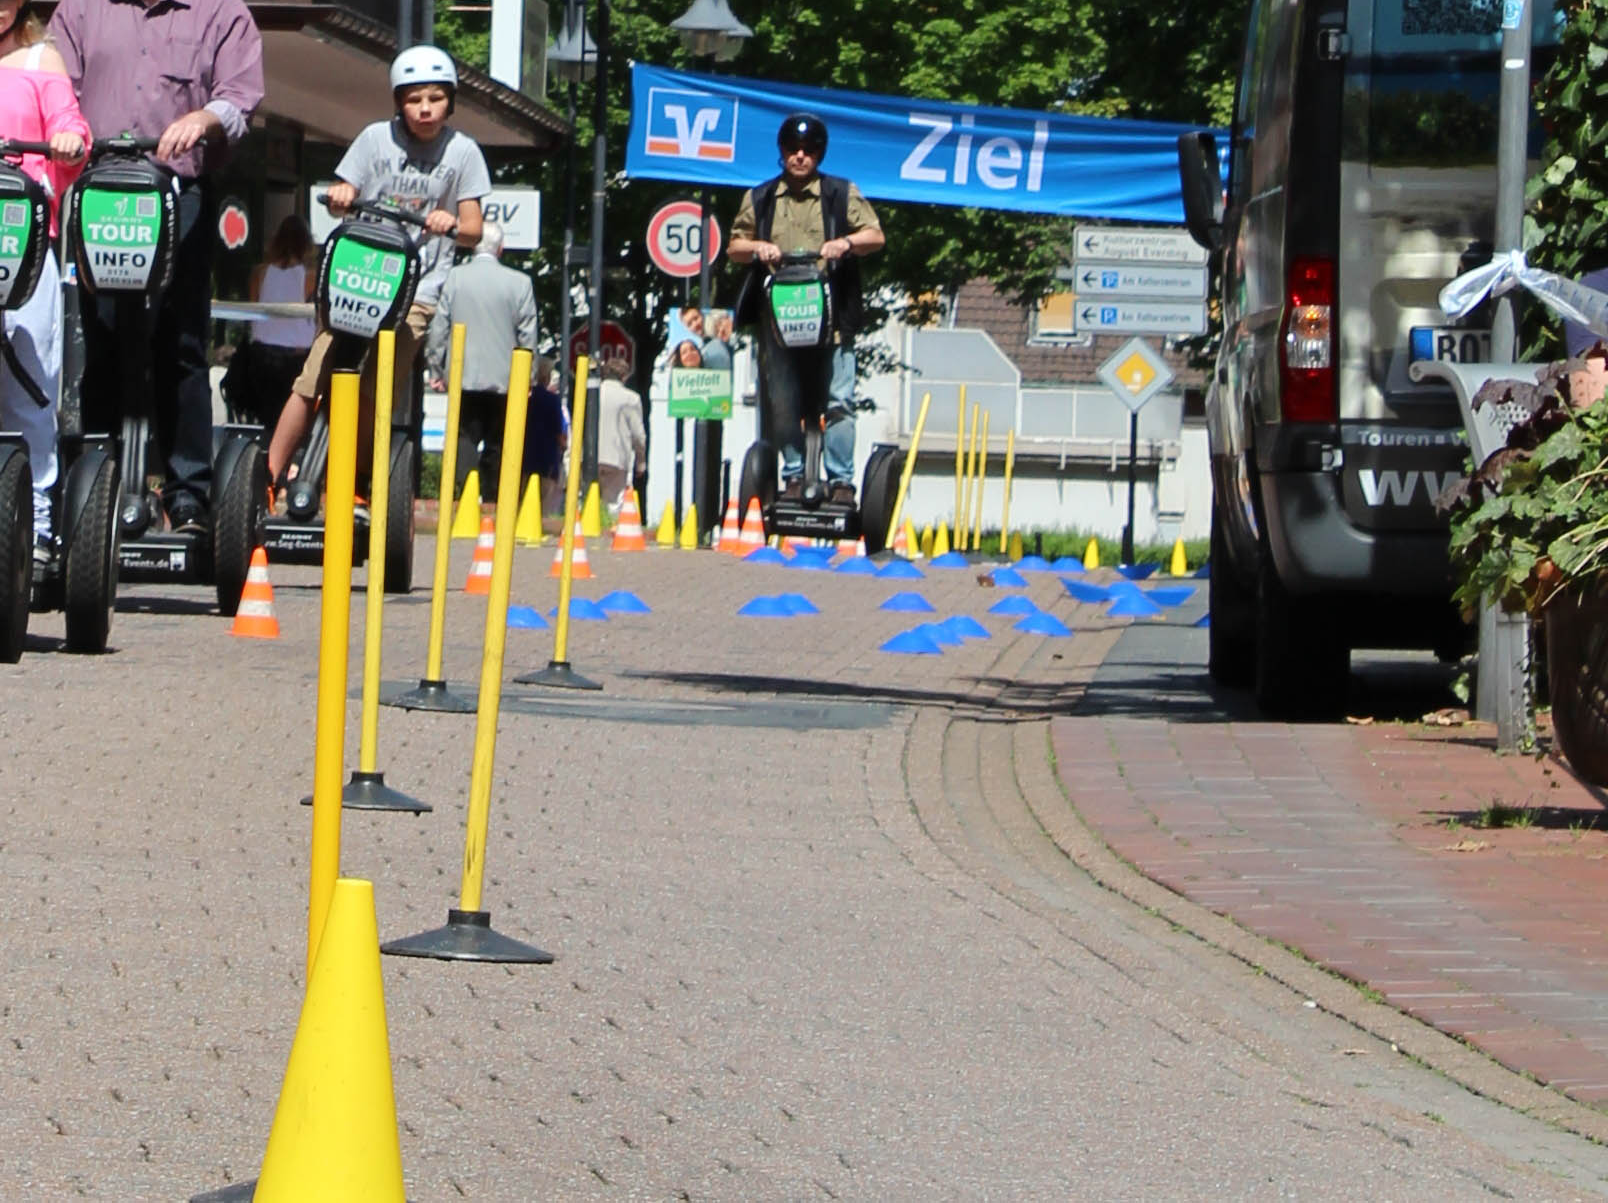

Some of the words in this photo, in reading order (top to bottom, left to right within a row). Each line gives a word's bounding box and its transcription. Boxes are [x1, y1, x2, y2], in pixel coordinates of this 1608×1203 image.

[900, 111, 1049, 192] Ziel
[392, 175, 429, 195] THAN
[88, 223, 152, 243] TOUR
[665, 224, 702, 254] 50
[95, 251, 147, 268] INFO
[336, 268, 392, 298] TOUR
[334, 295, 380, 318] INFO
[778, 305, 818, 316] TOUR
[783, 322, 816, 332] INFO
[677, 373, 720, 388] Vielfalt
[1357, 429, 1430, 447] Touren
